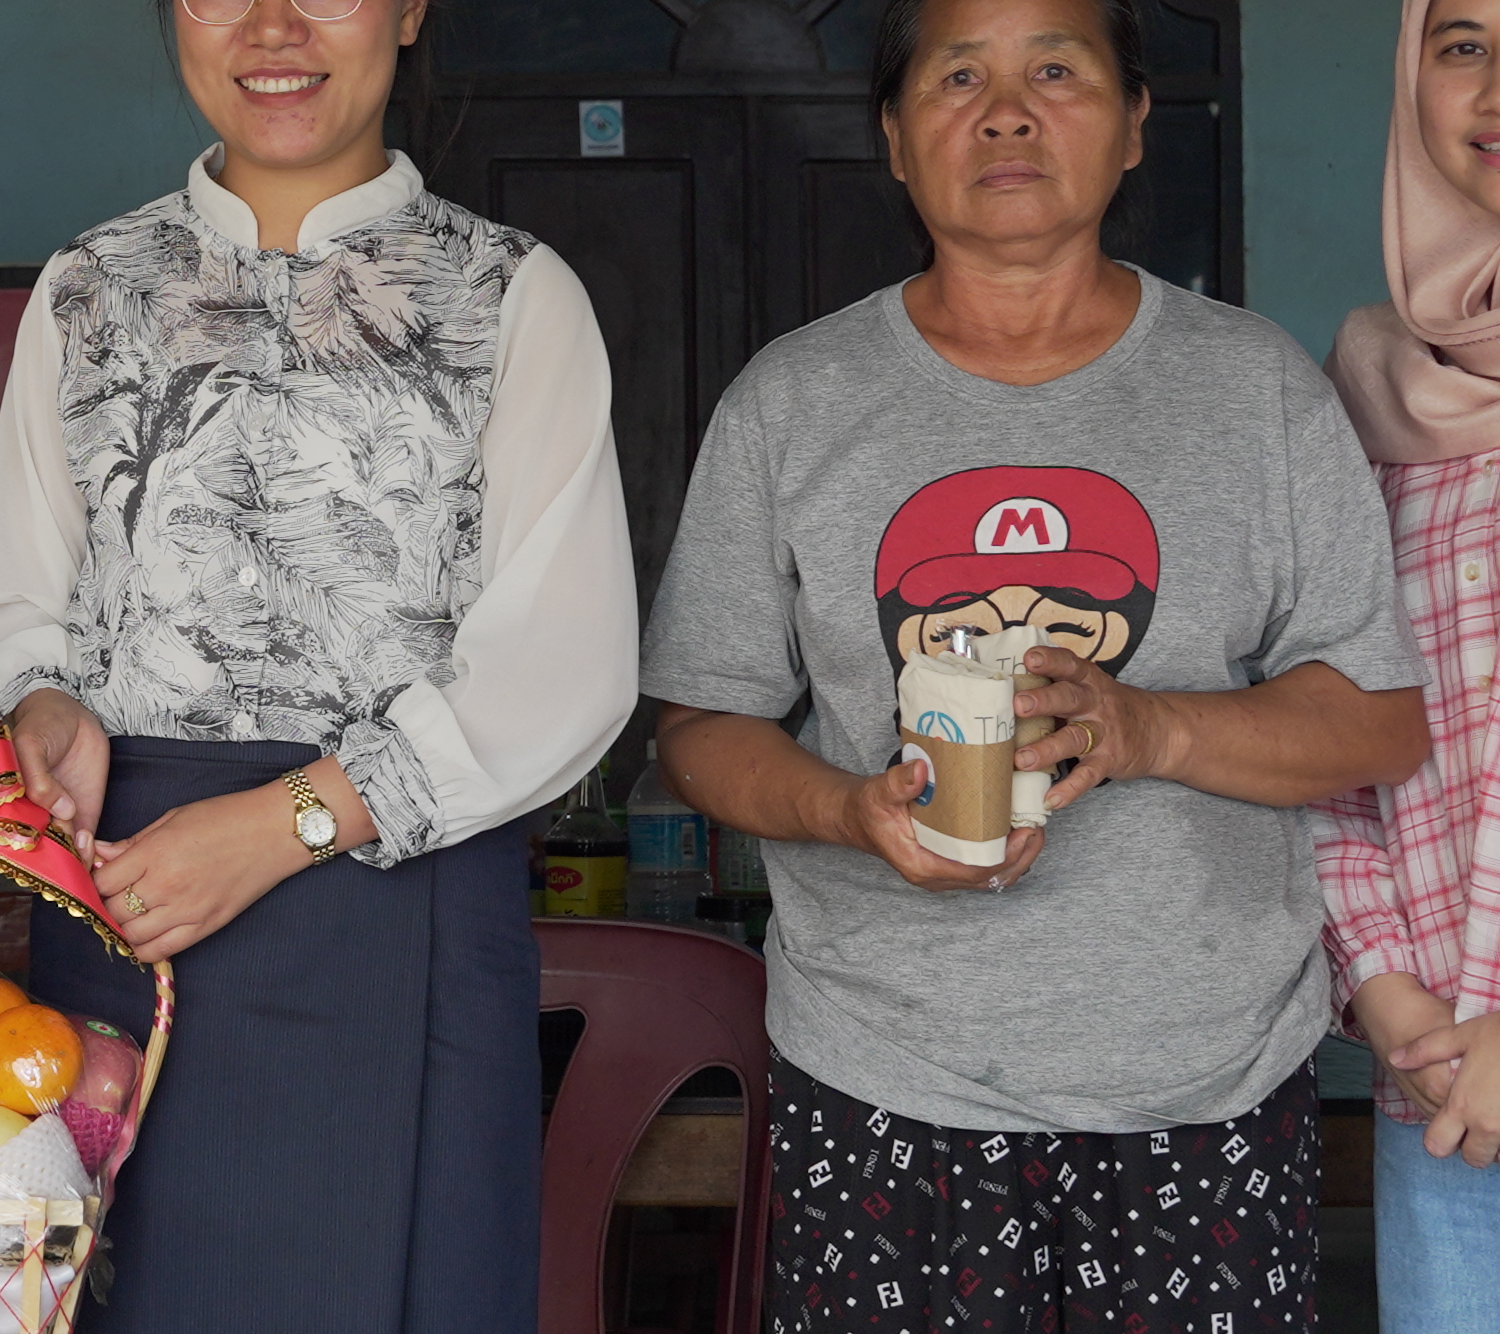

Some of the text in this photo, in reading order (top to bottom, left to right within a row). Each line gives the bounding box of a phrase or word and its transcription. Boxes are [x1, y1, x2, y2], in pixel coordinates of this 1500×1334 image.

[992, 507, 1050, 547] M
[996, 655, 1025, 675] Th
[862, 1149, 880, 1179] FENDI
[977, 1179, 1009, 1195] FENDI
[1213, 1175, 1233, 1205] FENDI
[1071, 1205, 1097, 1232] FENDI
[873, 1233, 901, 1260] FENDI
[1216, 1262, 1241, 1290] FENDI
